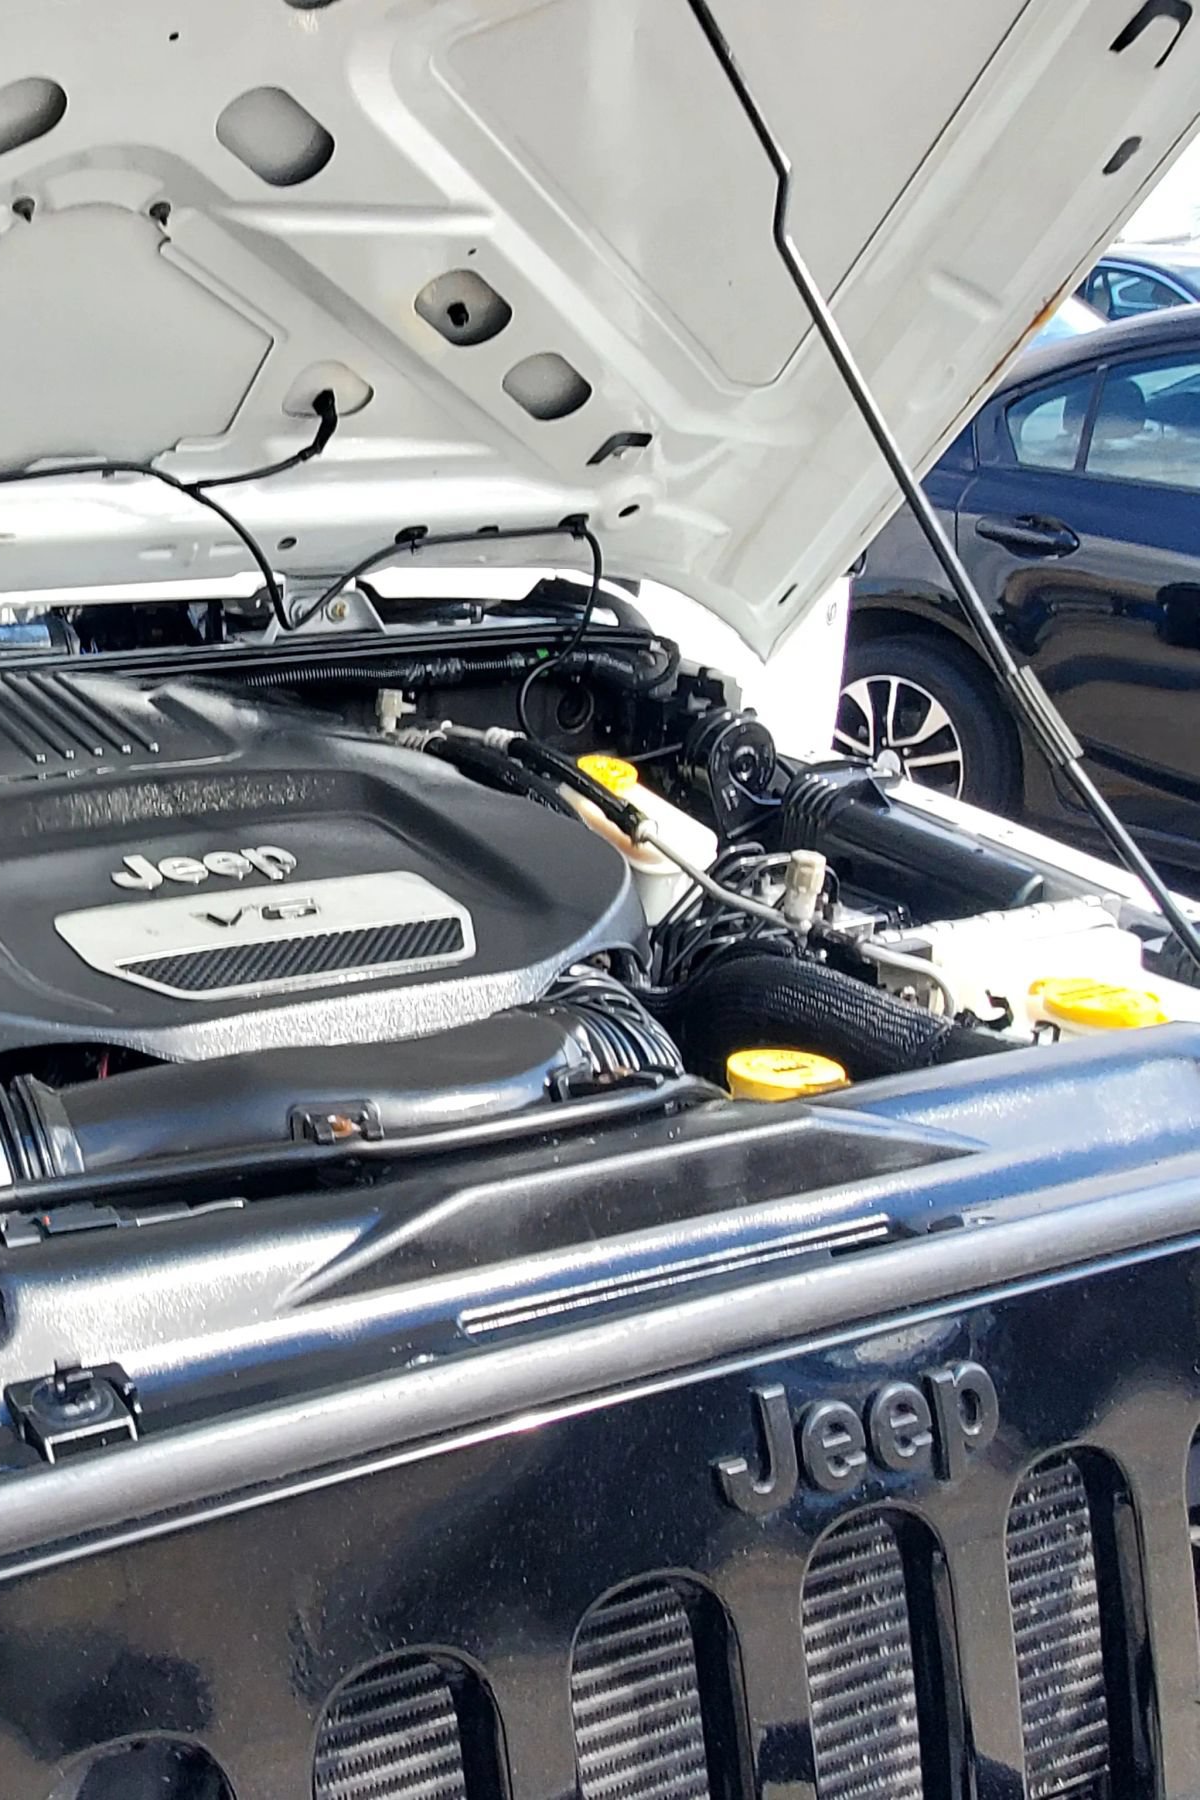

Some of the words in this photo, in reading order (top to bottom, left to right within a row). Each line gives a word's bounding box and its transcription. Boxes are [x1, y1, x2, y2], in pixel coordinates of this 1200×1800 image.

[112, 846, 297, 890] Jeep
[194, 899, 320, 927] V6
[715, 1360, 998, 1513] Jeep
